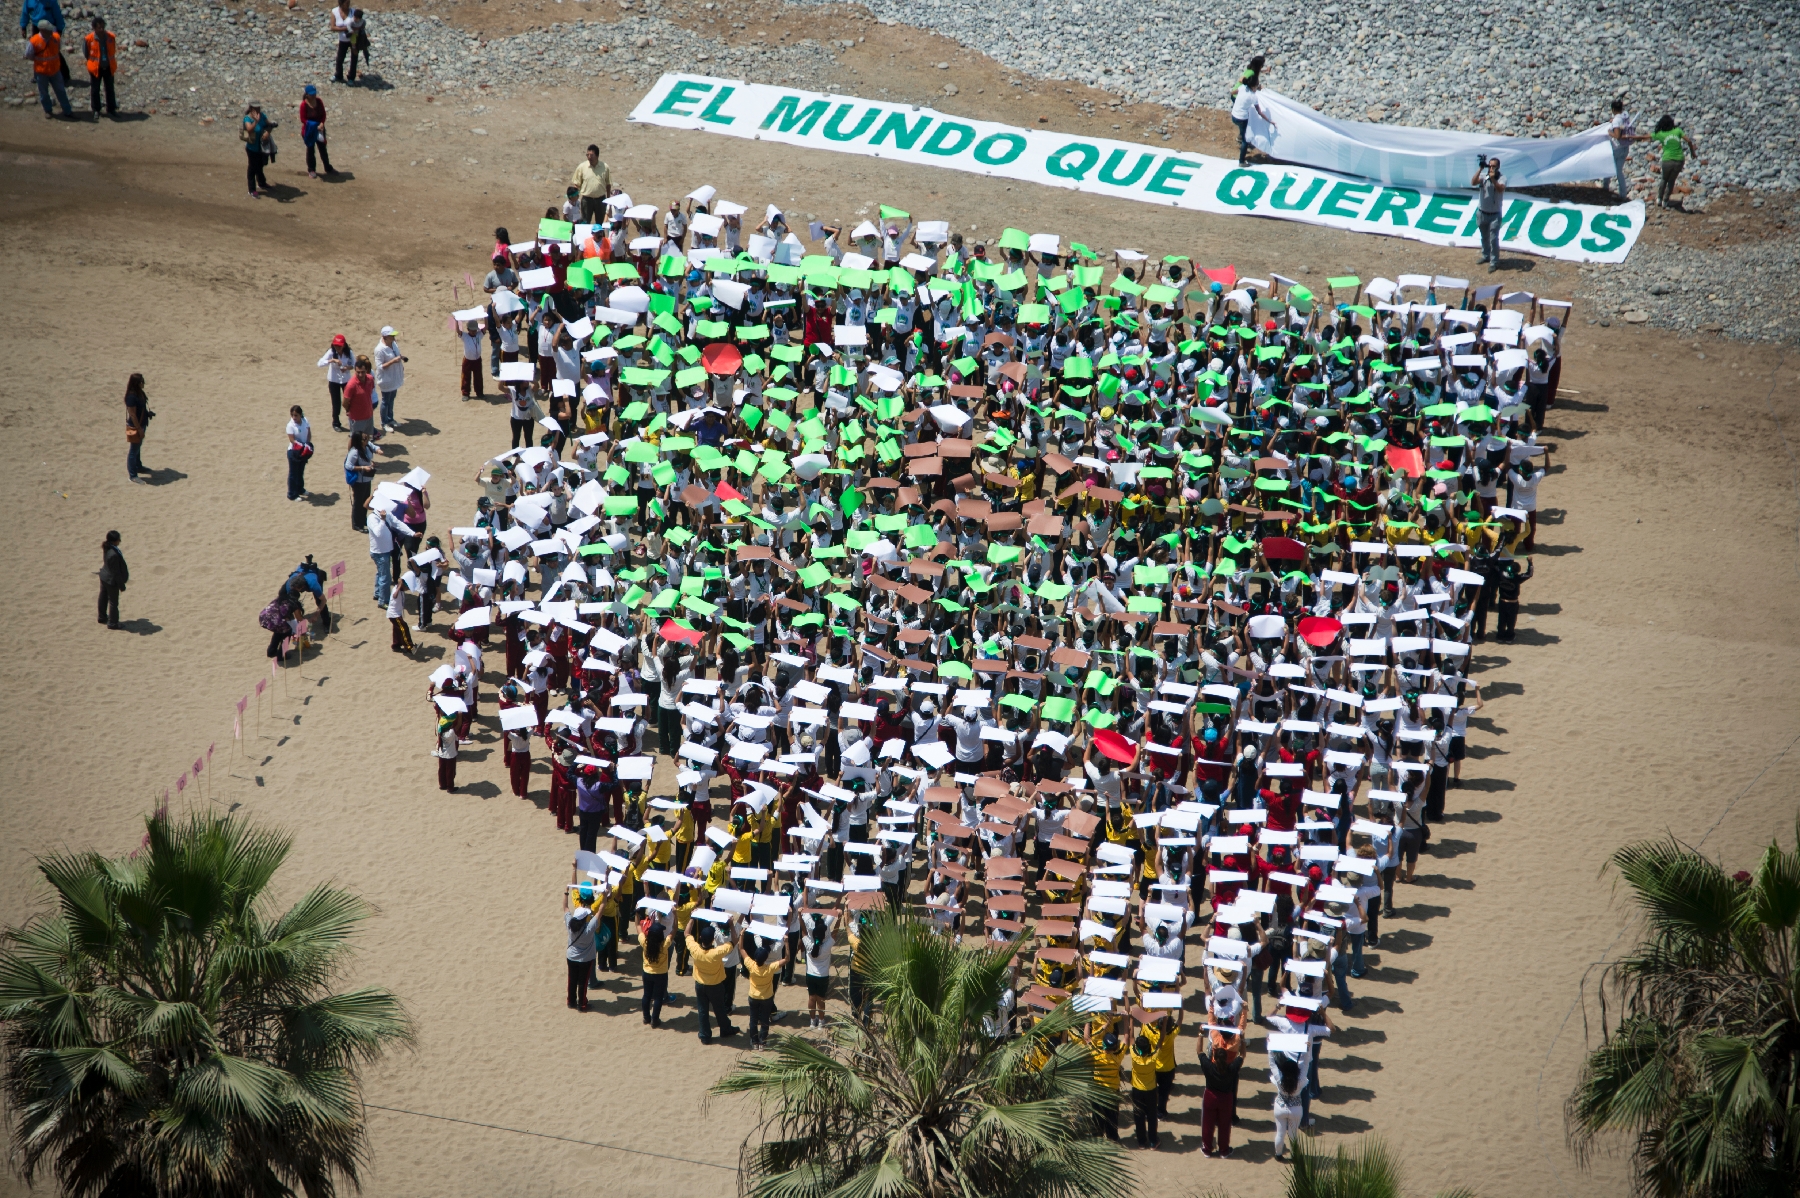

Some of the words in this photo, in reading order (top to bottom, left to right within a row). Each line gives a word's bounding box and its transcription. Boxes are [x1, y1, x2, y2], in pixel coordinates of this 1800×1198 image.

[653, 80, 737, 126] EL
[759, 95, 1028, 166] MUNDO
[1044, 142, 1203, 202] QUE
